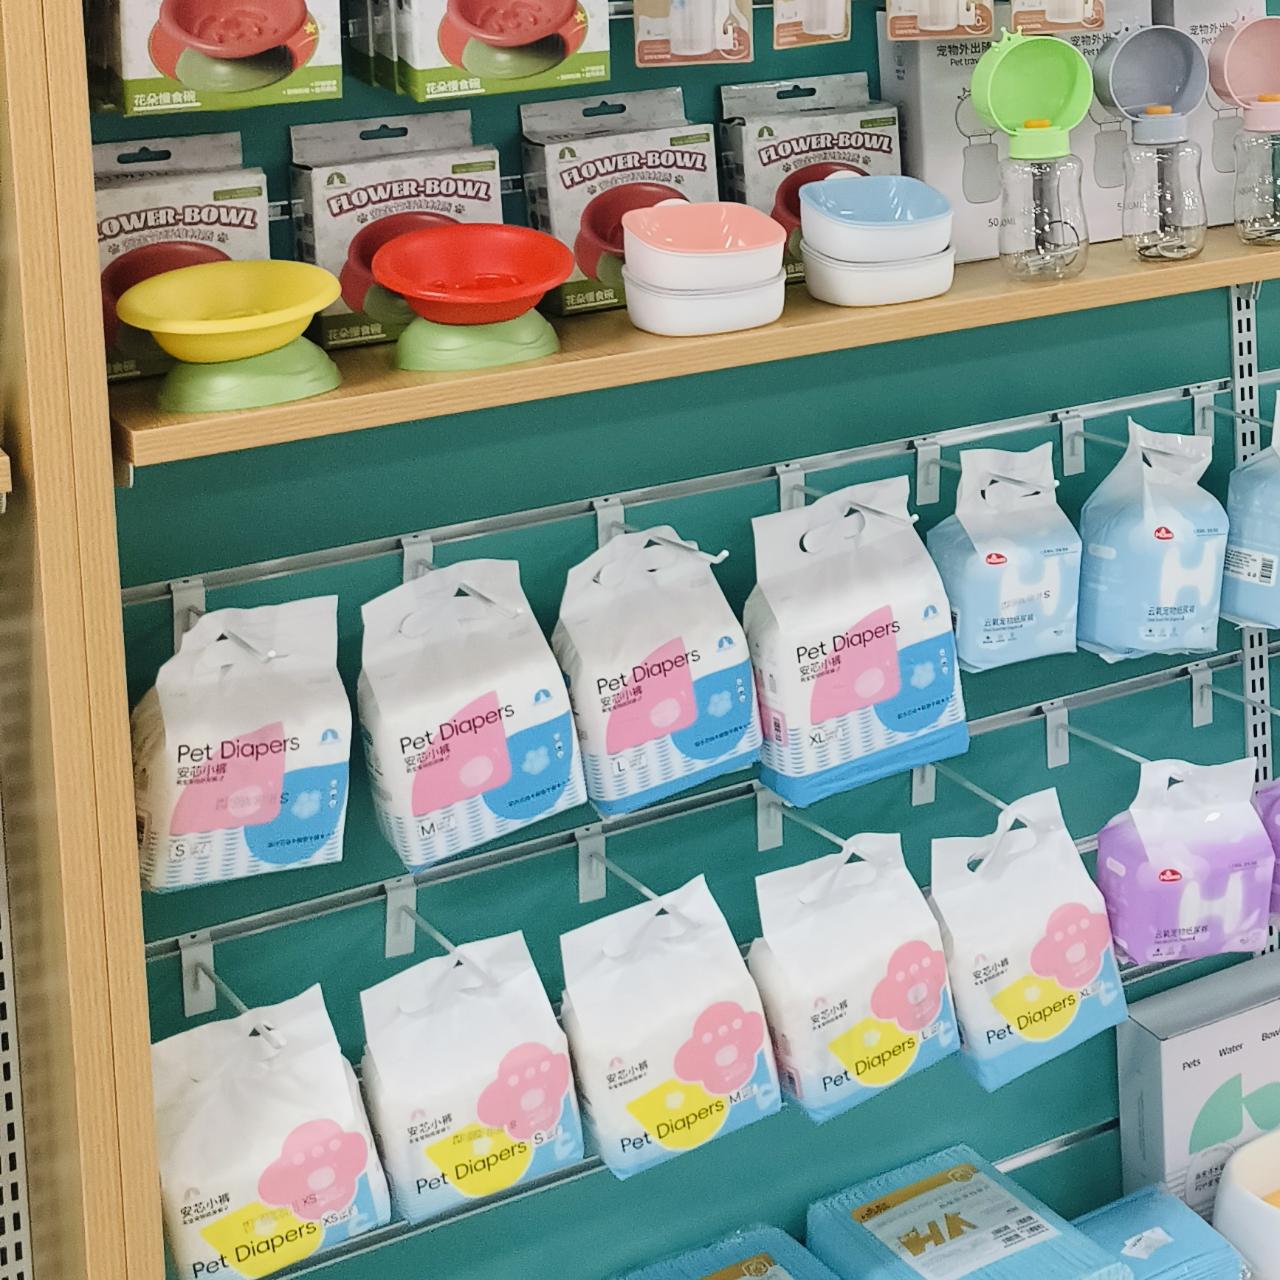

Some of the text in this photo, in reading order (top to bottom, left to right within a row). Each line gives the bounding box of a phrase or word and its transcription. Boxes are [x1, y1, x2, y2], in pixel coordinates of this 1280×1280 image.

[758, 131, 893, 167] FLOWER-BOWL
[559, 148, 708, 191] FLOWER-BOWL
[326, 177, 492, 218] FLOWER-BOWL
[97, 203, 258, 241] OWER-BOWL
[796, 620, 901, 663] Pet Diapers
[596, 648, 701, 695] Pet Diapers
[400, 703, 515, 754] Pet Diapers
[809, 733, 826, 746] XL
[177, 736, 300, 764] Pet Diapers
[617, 760, 625, 772] L
[420, 823, 436, 836] M
[175, 844, 185, 856] S
[985, 992, 1076, 1045] Pet Diapers
[822, 1036, 916, 1092] Pet Diapers
[1182, 1058, 1201, 1071] Pets
[1218, 1043, 1243, 1057] Water
[534, 1133, 544, 1144] S
[620, 1099, 725, 1153] Pet Diapers
[415, 1139, 527, 1194] Pet Diapers
[322, 1213, 339, 1225] XS
[192, 1222, 317, 1279] Pet Diapers
